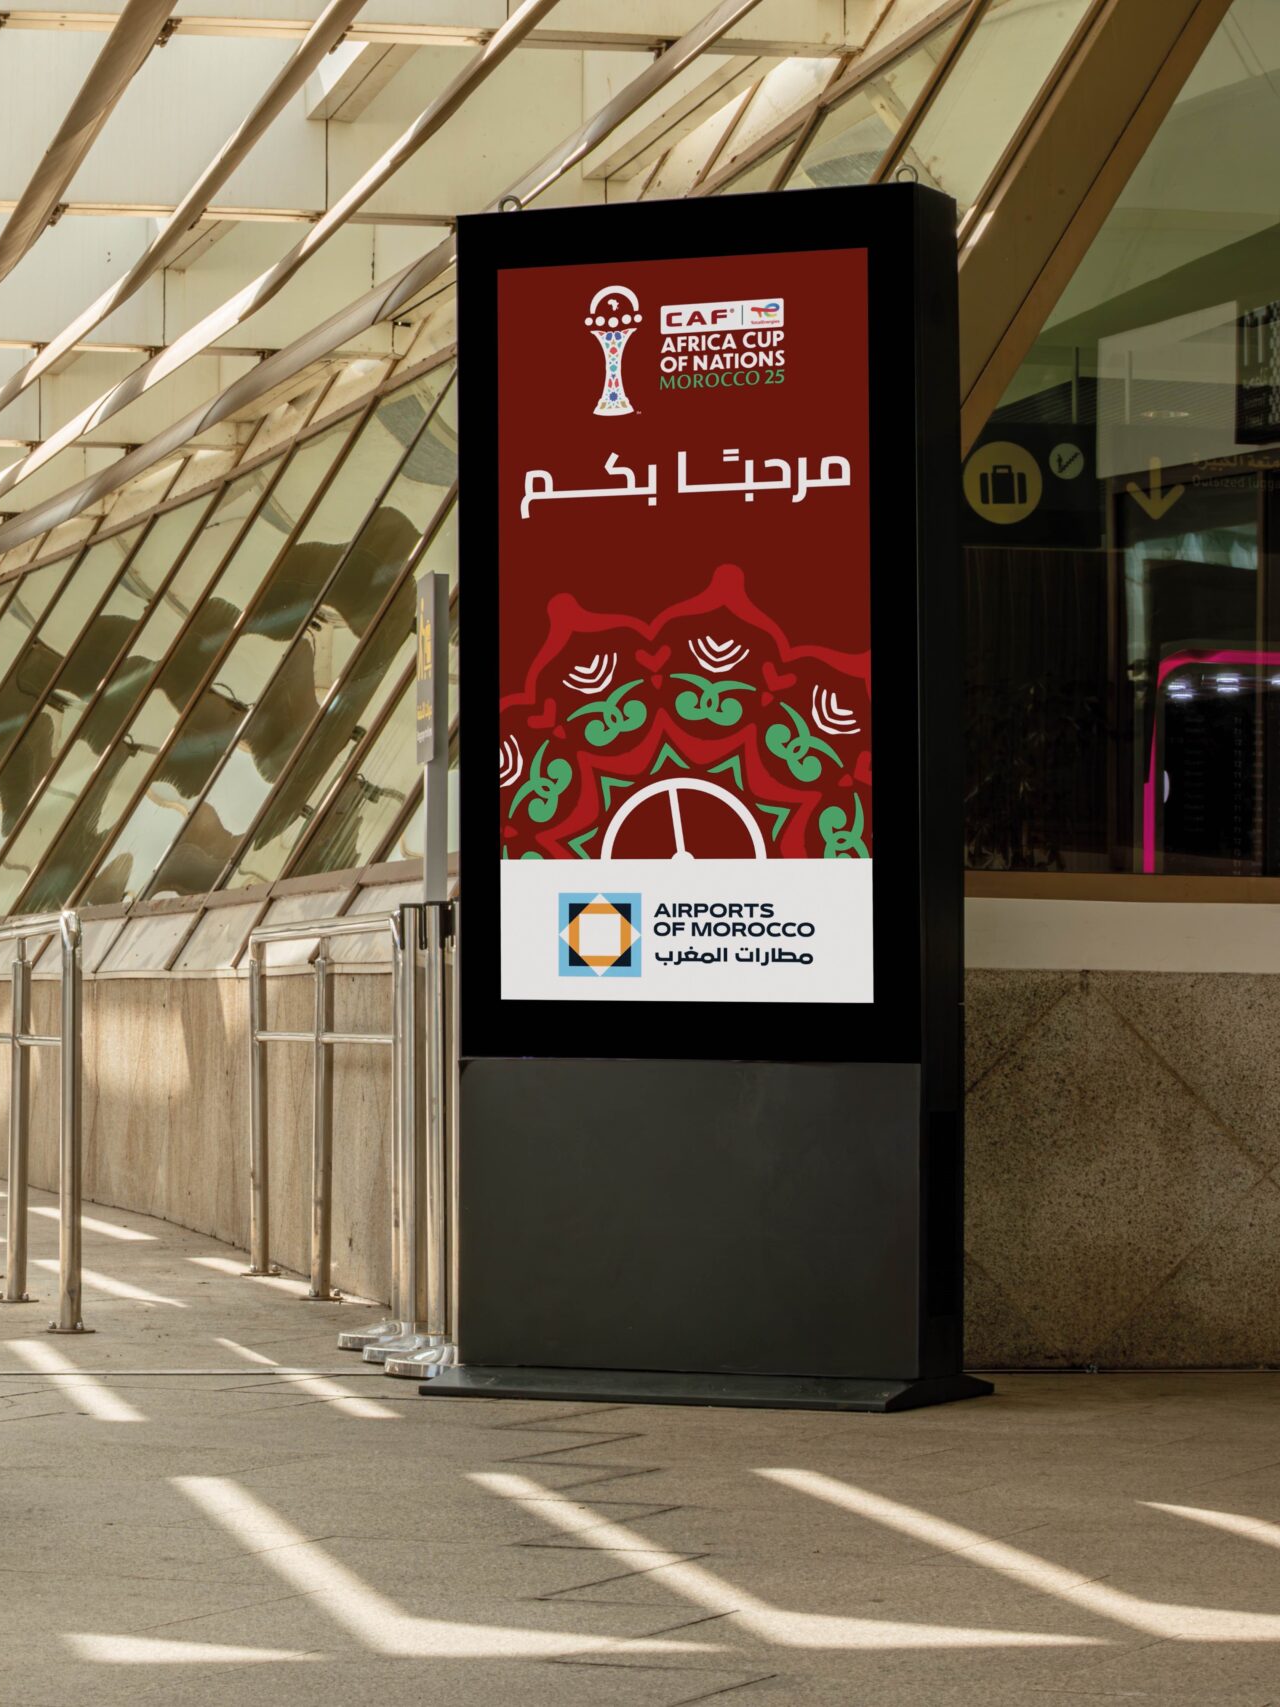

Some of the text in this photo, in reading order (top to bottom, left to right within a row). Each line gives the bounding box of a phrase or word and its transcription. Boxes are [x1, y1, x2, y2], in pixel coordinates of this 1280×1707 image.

[666, 309, 728, 328] CAF
[660, 330, 785, 354] AFRICA CUP
[660, 349, 785, 374] OF NATIONS
[659, 369, 785, 390] MOROCCO 25
[520, 452, 657, 520] بكم
[653, 903, 775, 918] AIRPORTS
[653, 921, 816, 938] OF MOROCCO
[654, 946, 814, 966] مطارات المغرب
